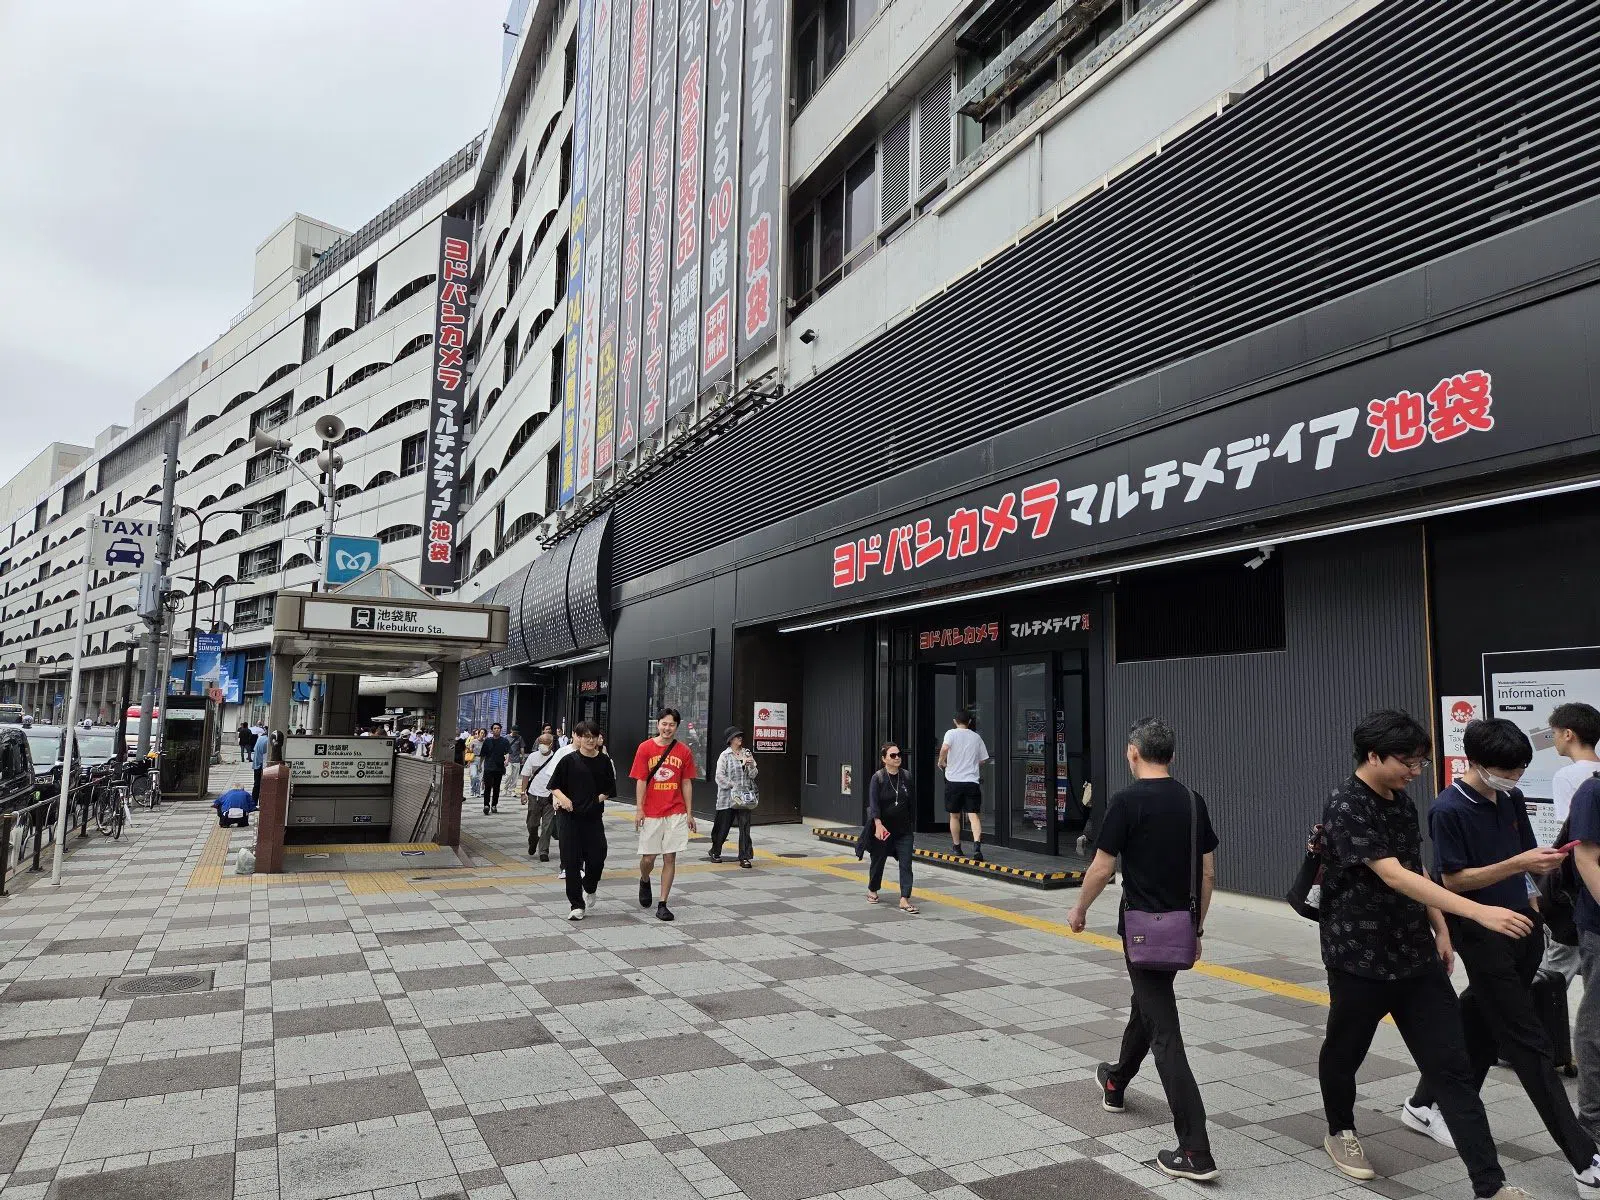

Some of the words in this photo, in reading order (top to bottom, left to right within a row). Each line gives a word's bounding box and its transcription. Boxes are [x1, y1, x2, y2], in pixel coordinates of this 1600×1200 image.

[684, 12, 701, 62] 3F
[655, 66, 670, 106] 4F
[630, 111, 643, 152] 5F
[708, 0, 735, 296] 分〜よる10時
[677, 55, 701, 269] 家電製品
[671, 263, 698, 320] 冷蔵庫
[437, 237, 469, 391] ヨドバシカメラ
[668, 364, 695, 407] エアコン
[428, 397, 458, 564] マルチメディア池袋
[102, 520, 153, 536] TAXI
[832, 478, 1061, 589] ヨドバシカメラ
[376, 622, 425, 634] Ikebukuro
[427, 625, 445, 635] Sta.
[377, 608, 418, 623] 池袋駅
[919, 622, 999, 649] ヨドバシカメラ
[1497, 686, 1567, 699] Information
